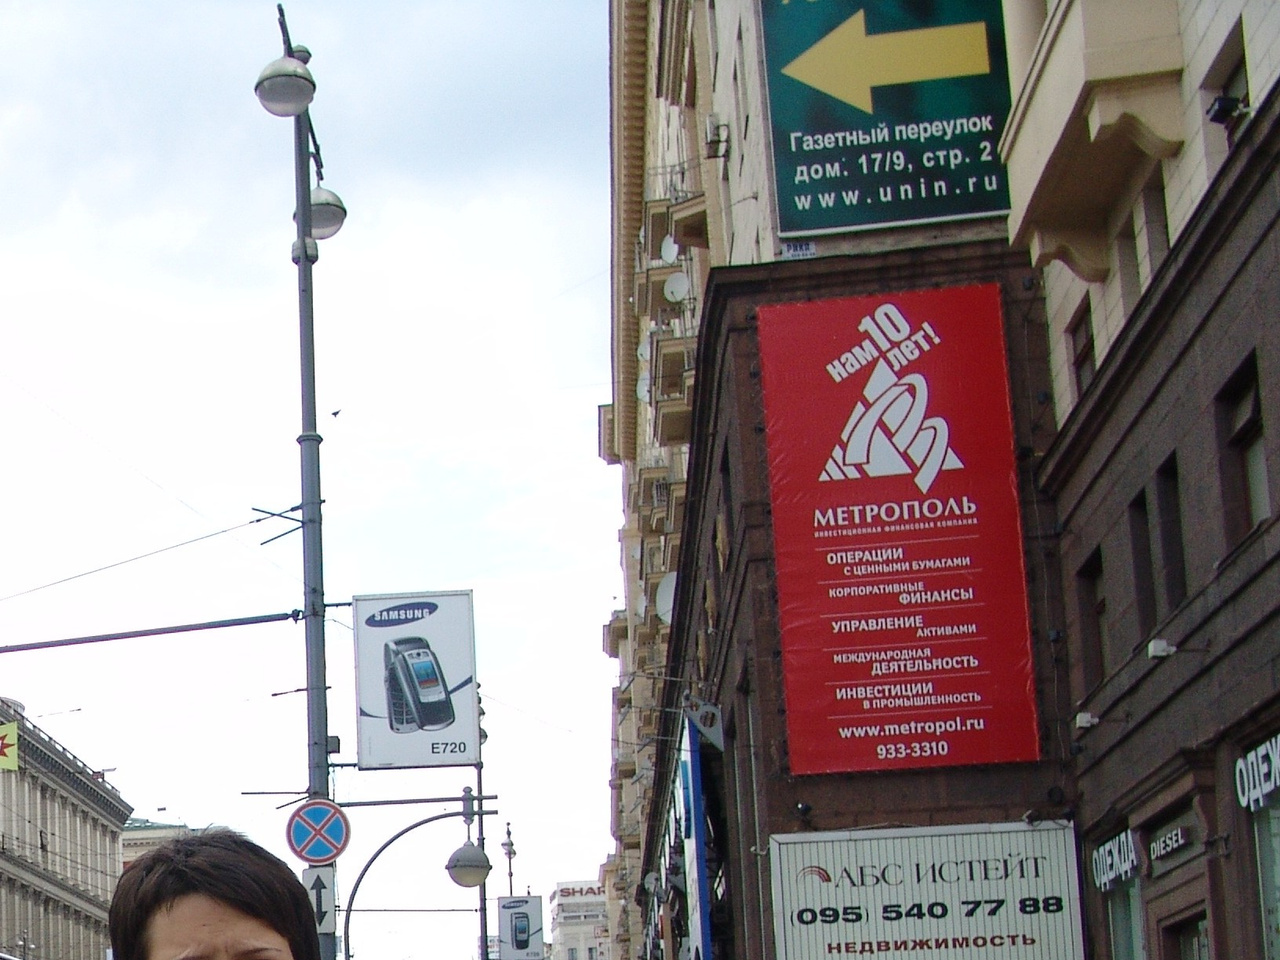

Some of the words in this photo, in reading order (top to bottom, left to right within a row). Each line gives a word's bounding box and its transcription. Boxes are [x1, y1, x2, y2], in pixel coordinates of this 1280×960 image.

[790, 123, 889, 151] Газетный
[894, 114, 993, 142] переулок
[858, 151, 913, 175] 17/9,
[923, 150, 970, 169] стр.
[980, 141, 993, 161] 2
[794, 174, 998, 210] www.unin.ru
[858, 302, 911, 353] 10
[885, 321, 941, 372] лет!
[813, 497, 977, 527] МЕТРОПОЛЬ
[814, 526, 882, 538] ИНВЕСТИЦИОННАЯ
[884, 521, 935, 532] ФИНАНСОВАЯ
[937, 517, 978, 528] КОМПАНИЯ
[827, 548, 903, 565] ОПЕРАЦИИ
[853, 561, 910, 576] ЦЕННЫМИ
[912, 556, 971, 571] БУМАГАМИ
[828, 582, 924, 598] КОРПОРАТИВНЫЕ
[899, 588, 973, 605] ФИНАНСЫ
[374, 609, 430, 621] SAMSUNG
[831, 616, 923, 633] УПРАВЛЕНИЕ
[916, 624, 977, 638] АКТИВАМИ
[833, 648, 931, 664] МЕЖДУНАРОДНАЯ
[871, 656, 979, 676] ДЕЯТЕЛЬНОСТЬ
[836, 682, 933, 700] ИНВЕСТИЦИИ
[863, 701, 870, 710] В
[873, 692, 981, 710] ПРОМЫШЛЕННОСТЬ
[839, 717, 985, 739] www.metropol.ru
[431, 742, 466, 754] E720
[877, 741, 948, 759] 933-3310
[1235, 733, 1280, 812] ОДЕЖ
[1150, 827, 1185, 860] DIESEL
[835, 863, 903, 888] АБС
[915, 852, 1047, 885] ИСТЕЙТ
[1092, 828, 1137, 892] ОДЕЖДА
[560, 887, 606, 897] SHAR
[790, 905, 870, 926] (095)
[881, 902, 948, 921] 540
[961, 899, 1005, 917] 77
[1019, 896, 1063, 915] 88
[827, 934, 1036, 955] НЕДВИЖИМОСТЬ
